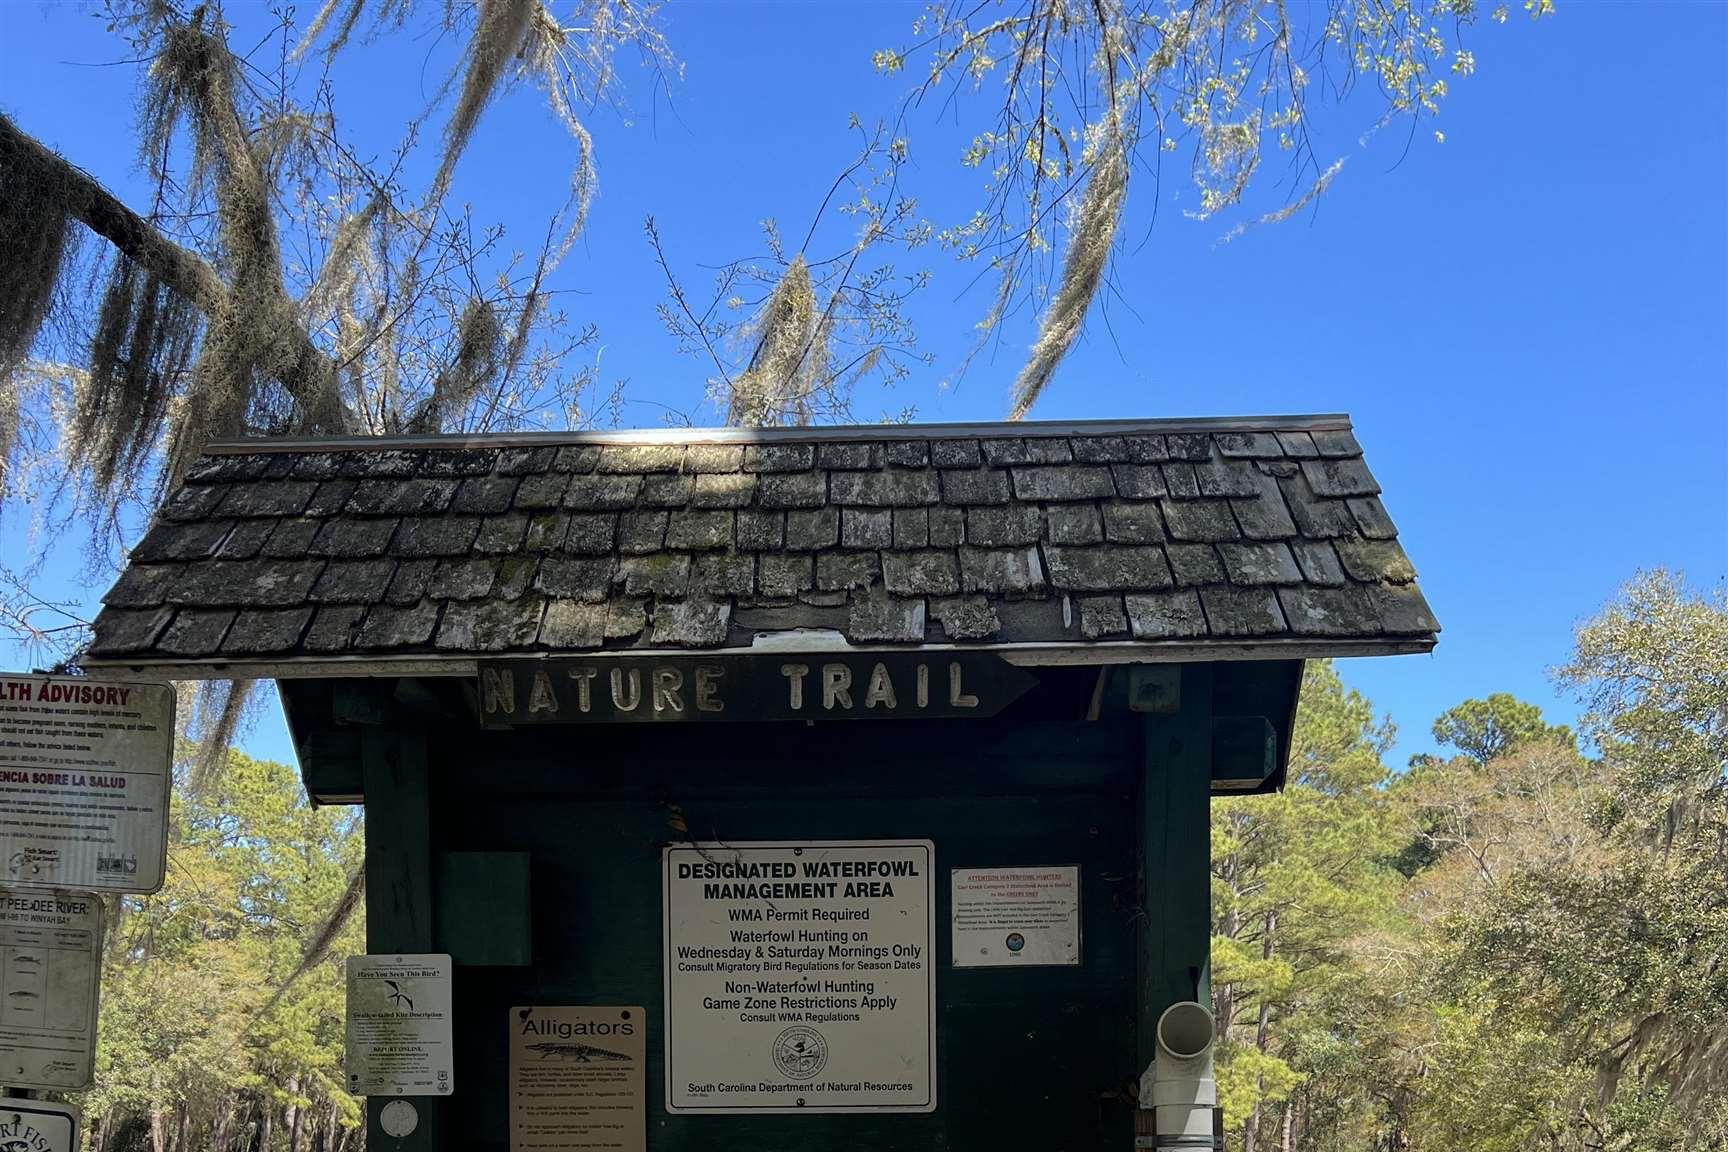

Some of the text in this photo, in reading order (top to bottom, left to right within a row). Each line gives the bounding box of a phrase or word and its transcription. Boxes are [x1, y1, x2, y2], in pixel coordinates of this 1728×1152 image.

[37, 683, 130, 706] ADVISORY
[482, 662, 980, 713] NATURE TRAIL
[32, 772, 69, 786] SOBRE
[72, 774, 86, 787] LA
[89, 776, 126, 789] SALUD
[678, 861, 919, 880] DESIGNATED WATERFOWL
[704, 882, 895, 899] MANAGEMENT AREA
[7, 898, 28, 911] PEE
[33, 899, 54, 913] DEE
[728, 908, 870, 923] WMA Permit Required
[730, 930, 868, 945] Waterfowl Hunting on
[678, 944, 921, 961] Wednesday & Saturday Mornings Only
[357, 971, 374, 979] Have
[375, 970, 388, 978] You
[389, 970, 405, 978] Seen
[678, 959, 921, 974] Consult Migratory Bird Regulations for Season Dates
[725, 979, 875, 995] Non-Waterfowl Hunting
[703, 995, 897, 1011] Game Zone Restrictions Apply
[740, 1013, 860, 1024] Consult WMA Regulations
[521, 1019, 634, 1040] Alligators
[688, 1081, 913, 1095] South Carolina Department of Natural Resources
